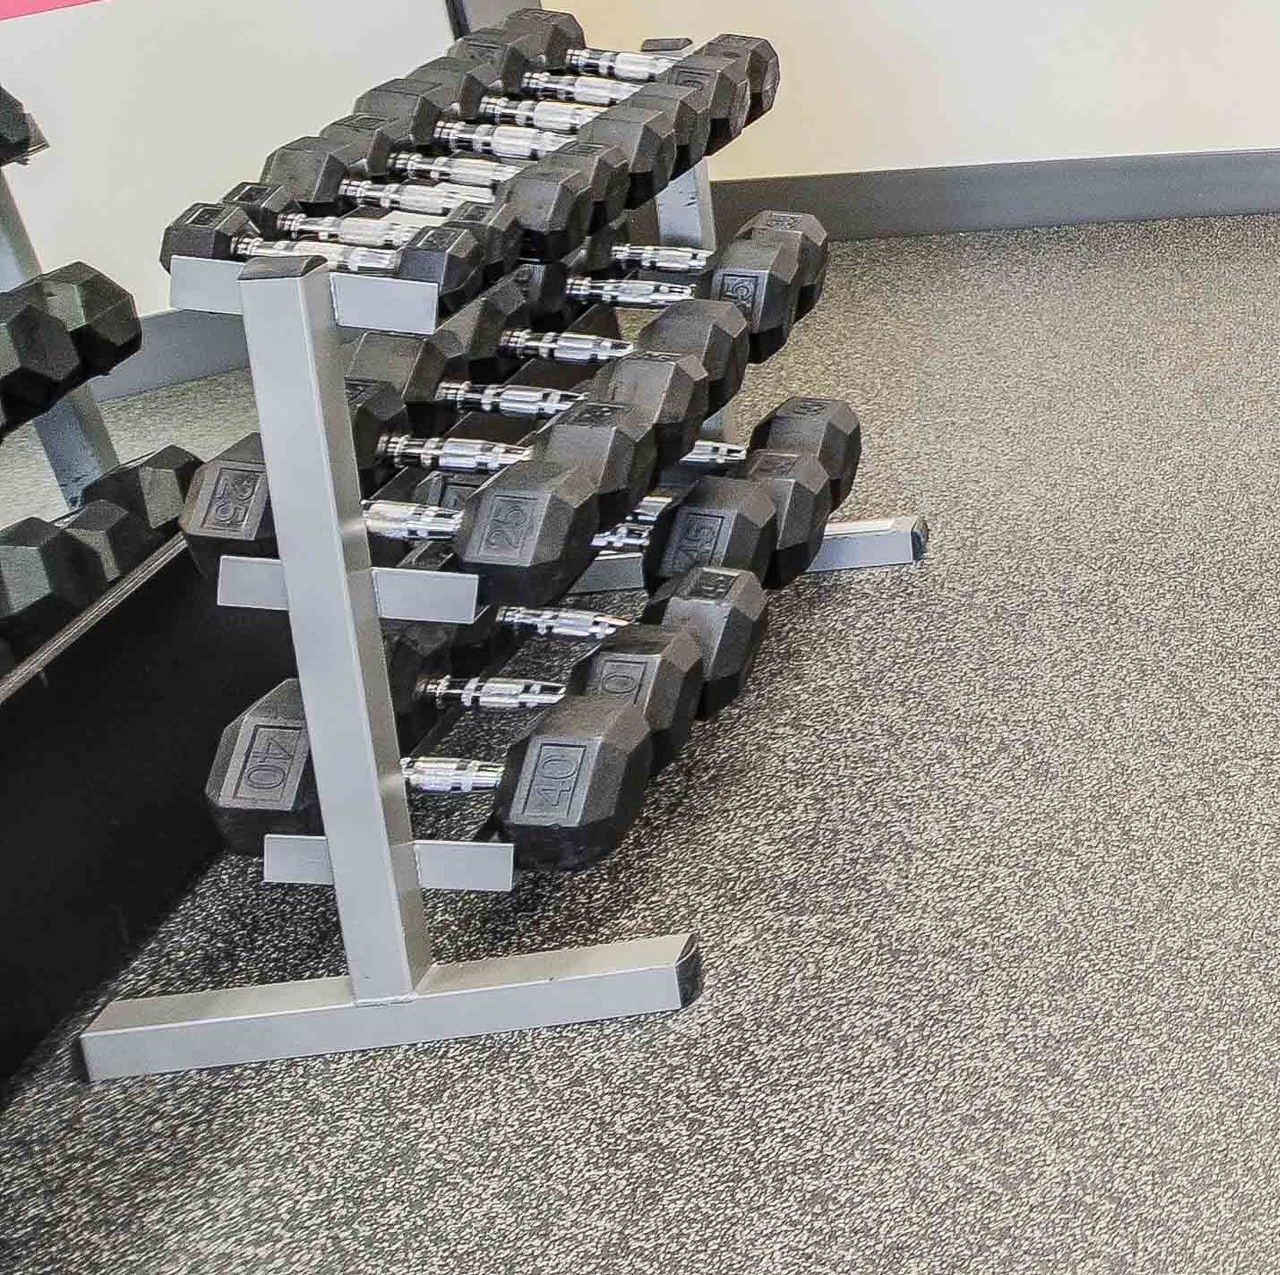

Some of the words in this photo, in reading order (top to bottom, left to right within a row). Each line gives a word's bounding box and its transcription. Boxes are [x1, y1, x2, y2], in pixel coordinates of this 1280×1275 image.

[213, 475, 258, 523] 25
[485, 505, 529, 551] 25
[246, 736, 294, 790] 40
[535, 756, 579, 808] 40
